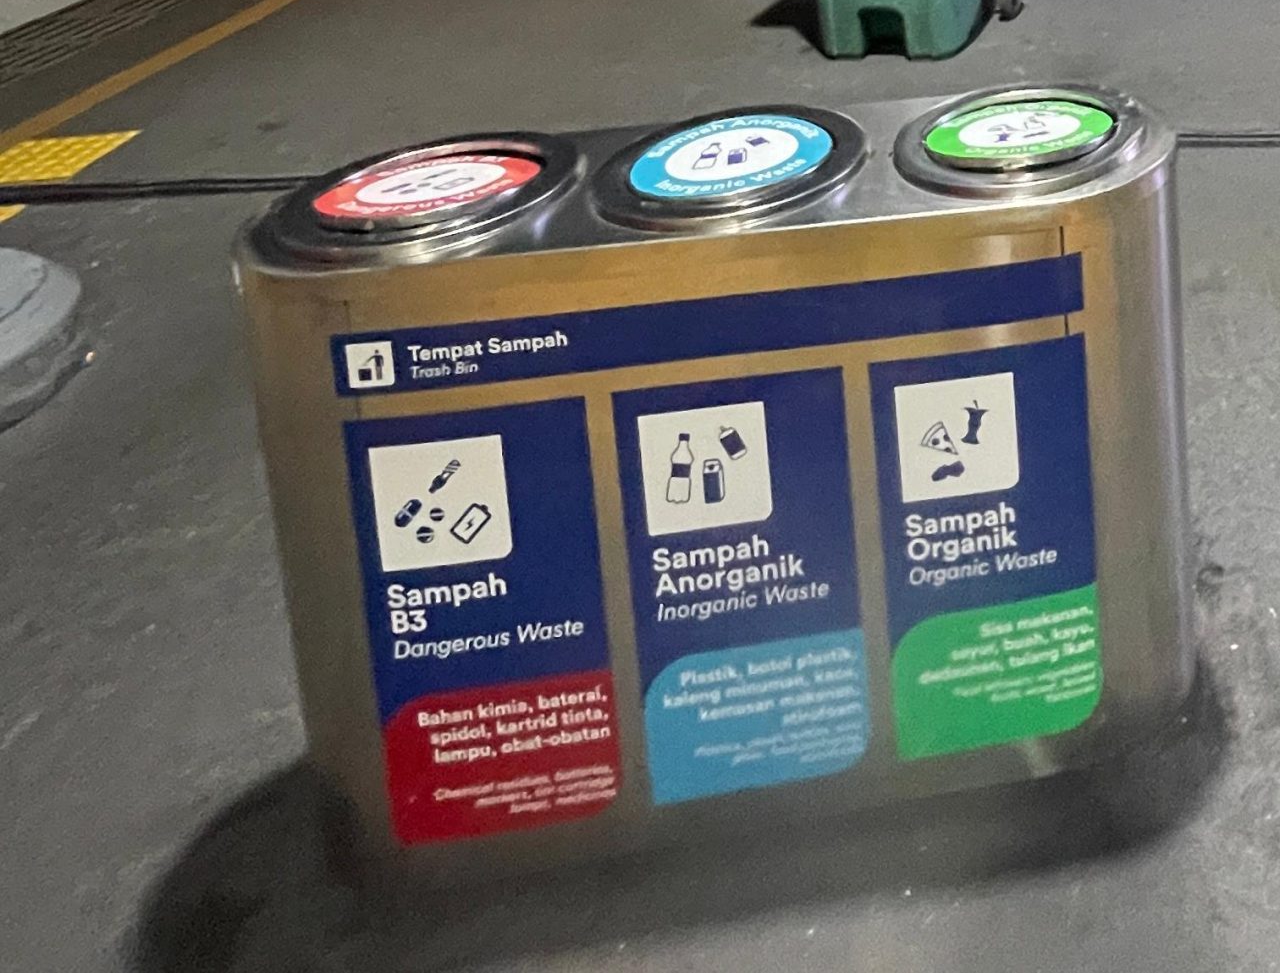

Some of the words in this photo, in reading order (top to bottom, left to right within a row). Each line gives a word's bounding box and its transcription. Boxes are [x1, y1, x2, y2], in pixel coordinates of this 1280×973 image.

[407, 340, 484, 362] Tempat
[488, 330, 568, 355] Sampah
[409, 362, 451, 379] Trash
[454, 360, 479, 375] Bin
[905, 501, 1016, 537] Sampah
[652, 533, 770, 571] Sampah
[907, 525, 1018, 562] Organik
[655, 553, 805, 598] Anorganik
[909, 558, 990, 587] Organic
[995, 548, 1058, 572] Waste
[387, 572, 508, 608] Sampah
[656, 589, 758, 622] Inorganic
[764, 581, 830, 605] Waste
[390, 609, 428, 635] B3
[394, 631, 511, 660] Dangerous
[516, 620, 585, 643] Waste
[417, 708, 474, 727] Bahan
[430, 723, 492, 746] spidol,
[496, 712, 558, 734] kartrid
[434, 744, 498, 763] lampu,
[501, 726, 611, 754] obat-obatan
